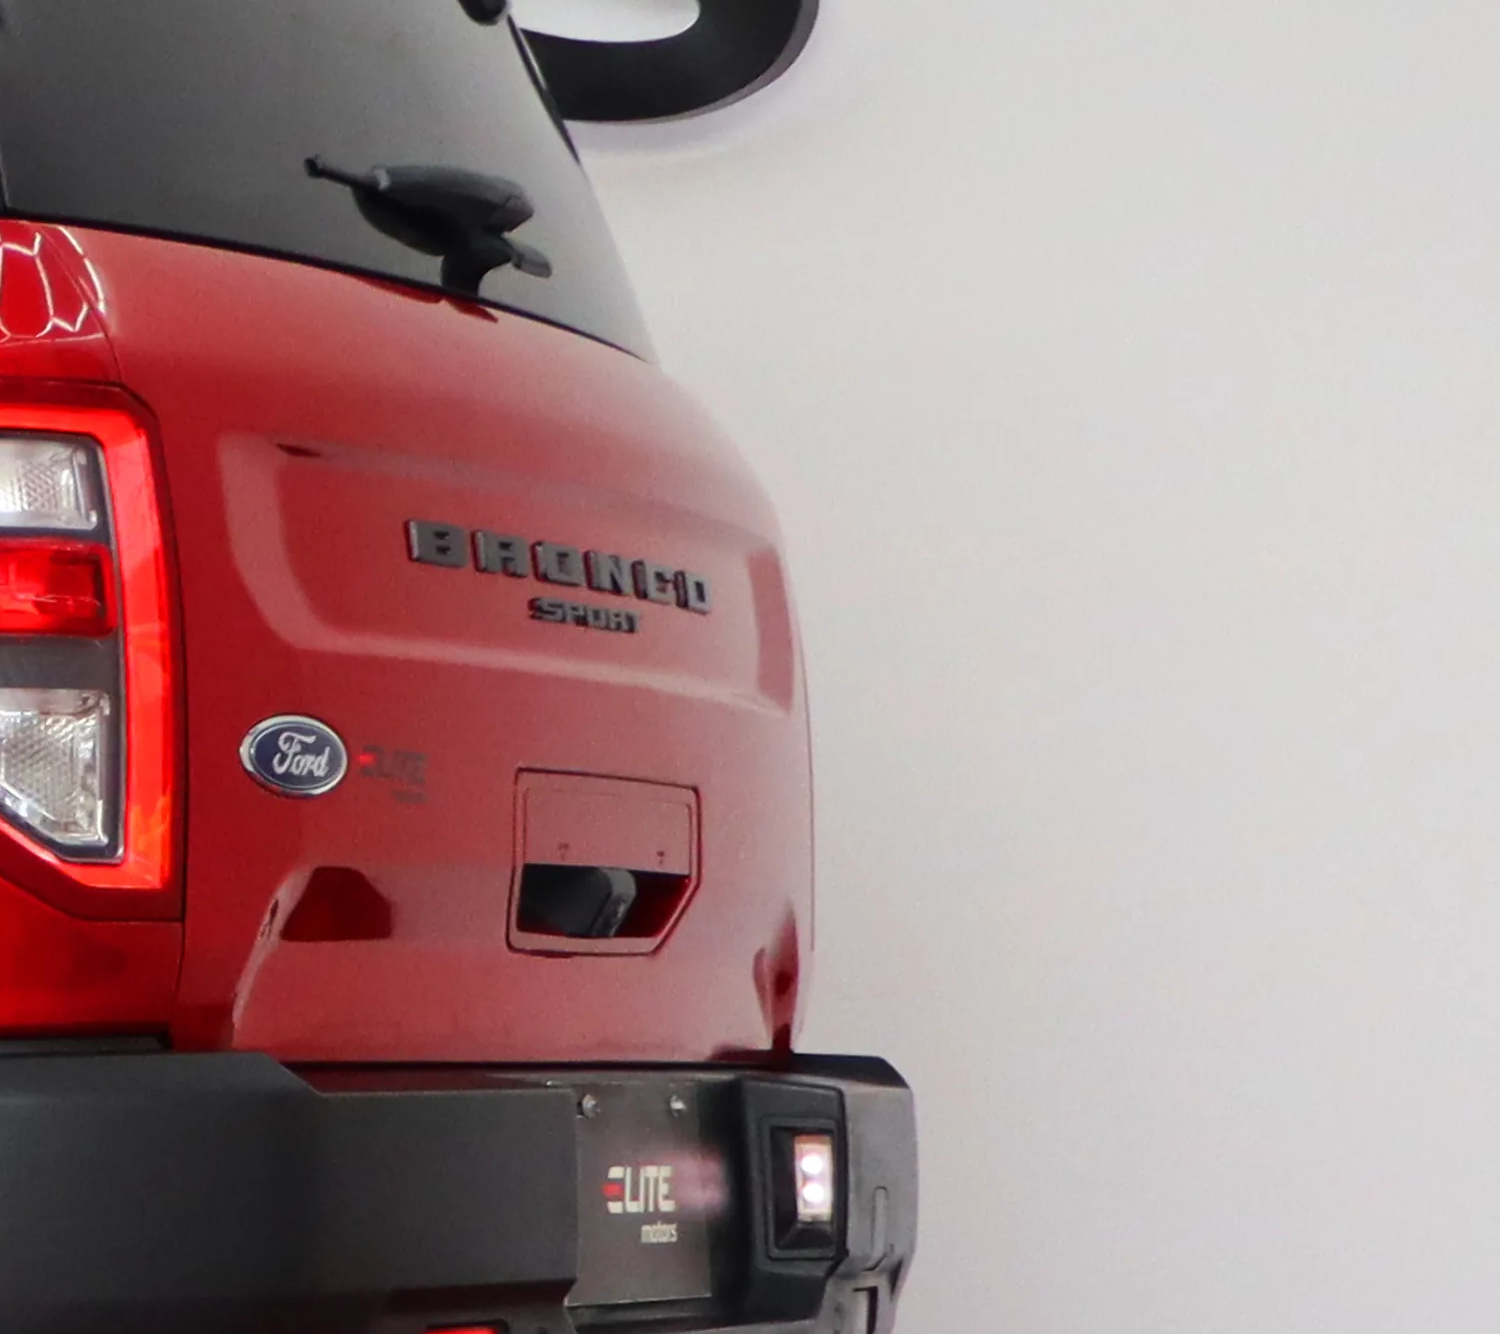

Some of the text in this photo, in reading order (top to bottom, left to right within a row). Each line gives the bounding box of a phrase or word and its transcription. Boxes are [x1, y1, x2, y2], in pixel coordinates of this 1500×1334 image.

[405, 519, 715, 615] BRONCO
[527, 597, 641, 633] SPORT
[272, 730, 332, 778] Ford
[603, 1165, 676, 1215] ELITE
